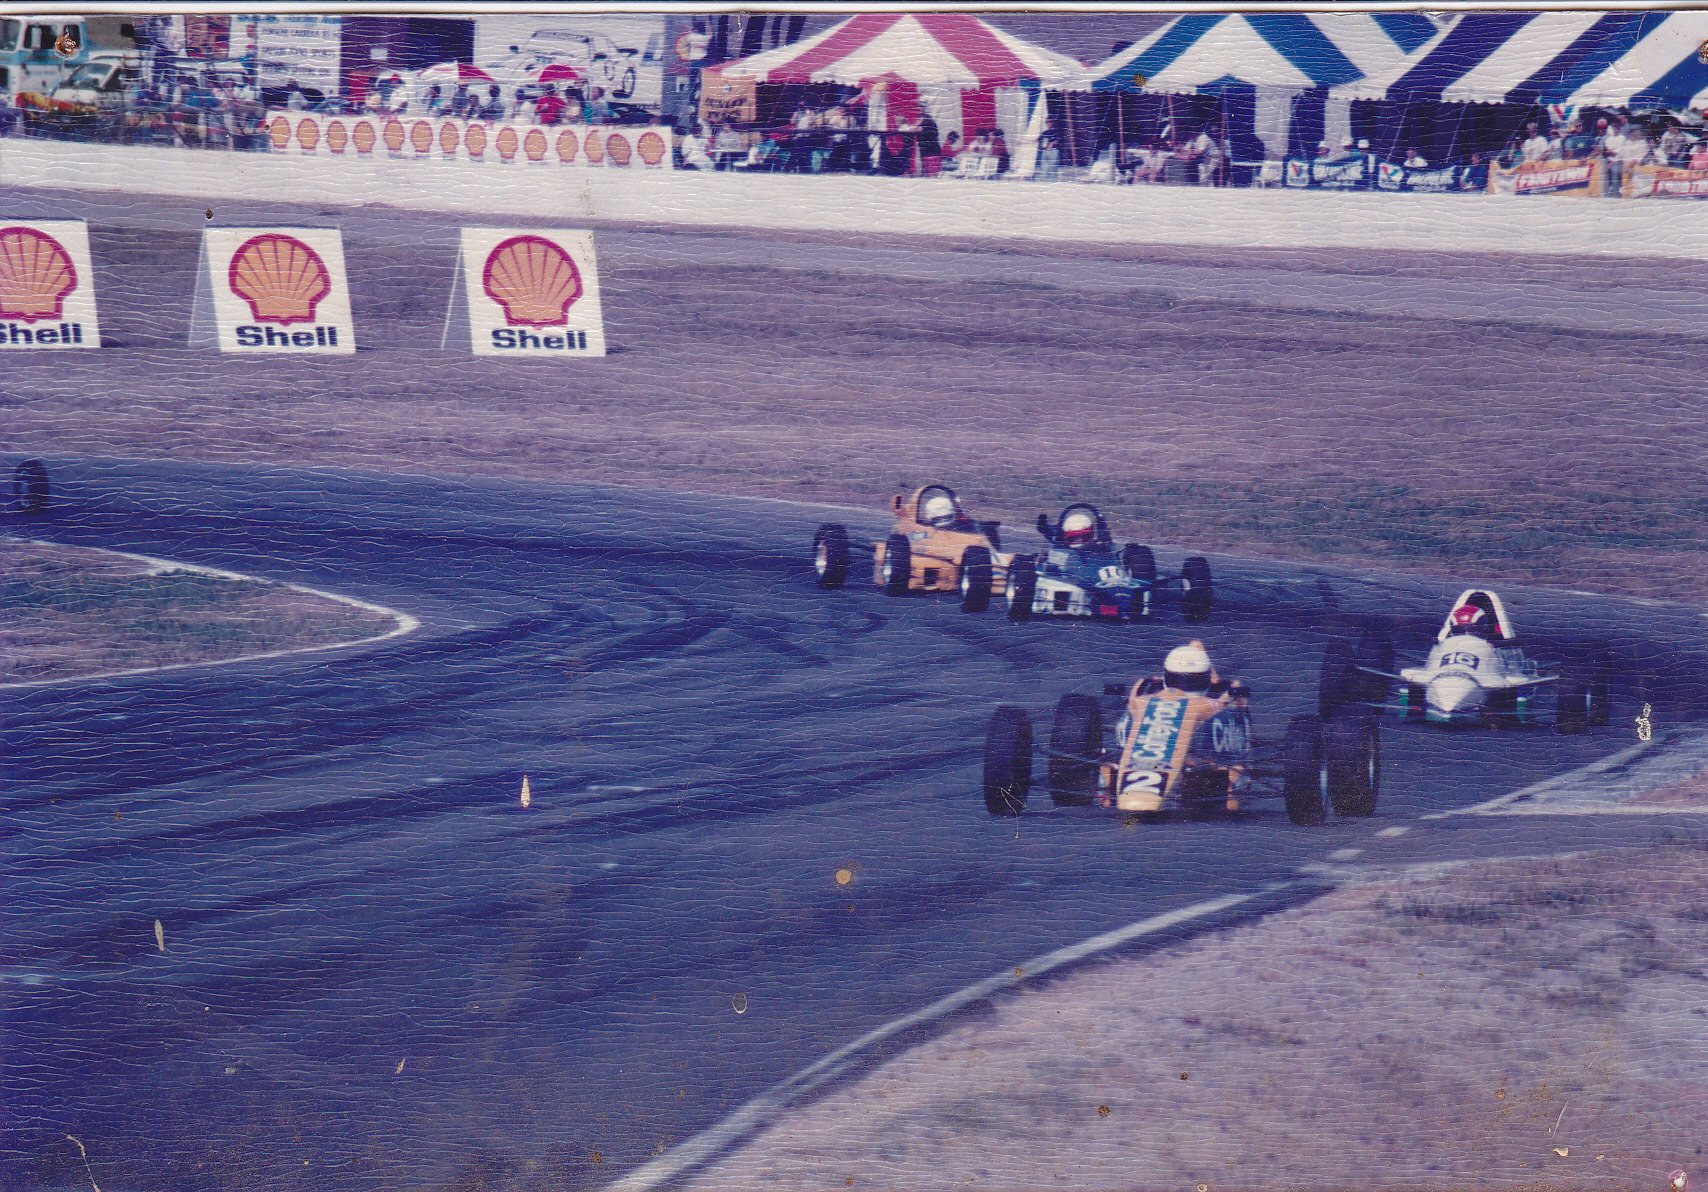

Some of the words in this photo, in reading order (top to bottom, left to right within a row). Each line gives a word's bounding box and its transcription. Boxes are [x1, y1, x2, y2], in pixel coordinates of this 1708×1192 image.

[0, 322, 83, 344] hell
[235, 325, 338, 347] Shell
[491, 328, 588, 350] Shell
[1442, 651, 1477, 668] 16
[1123, 771, 1162, 795] 2
